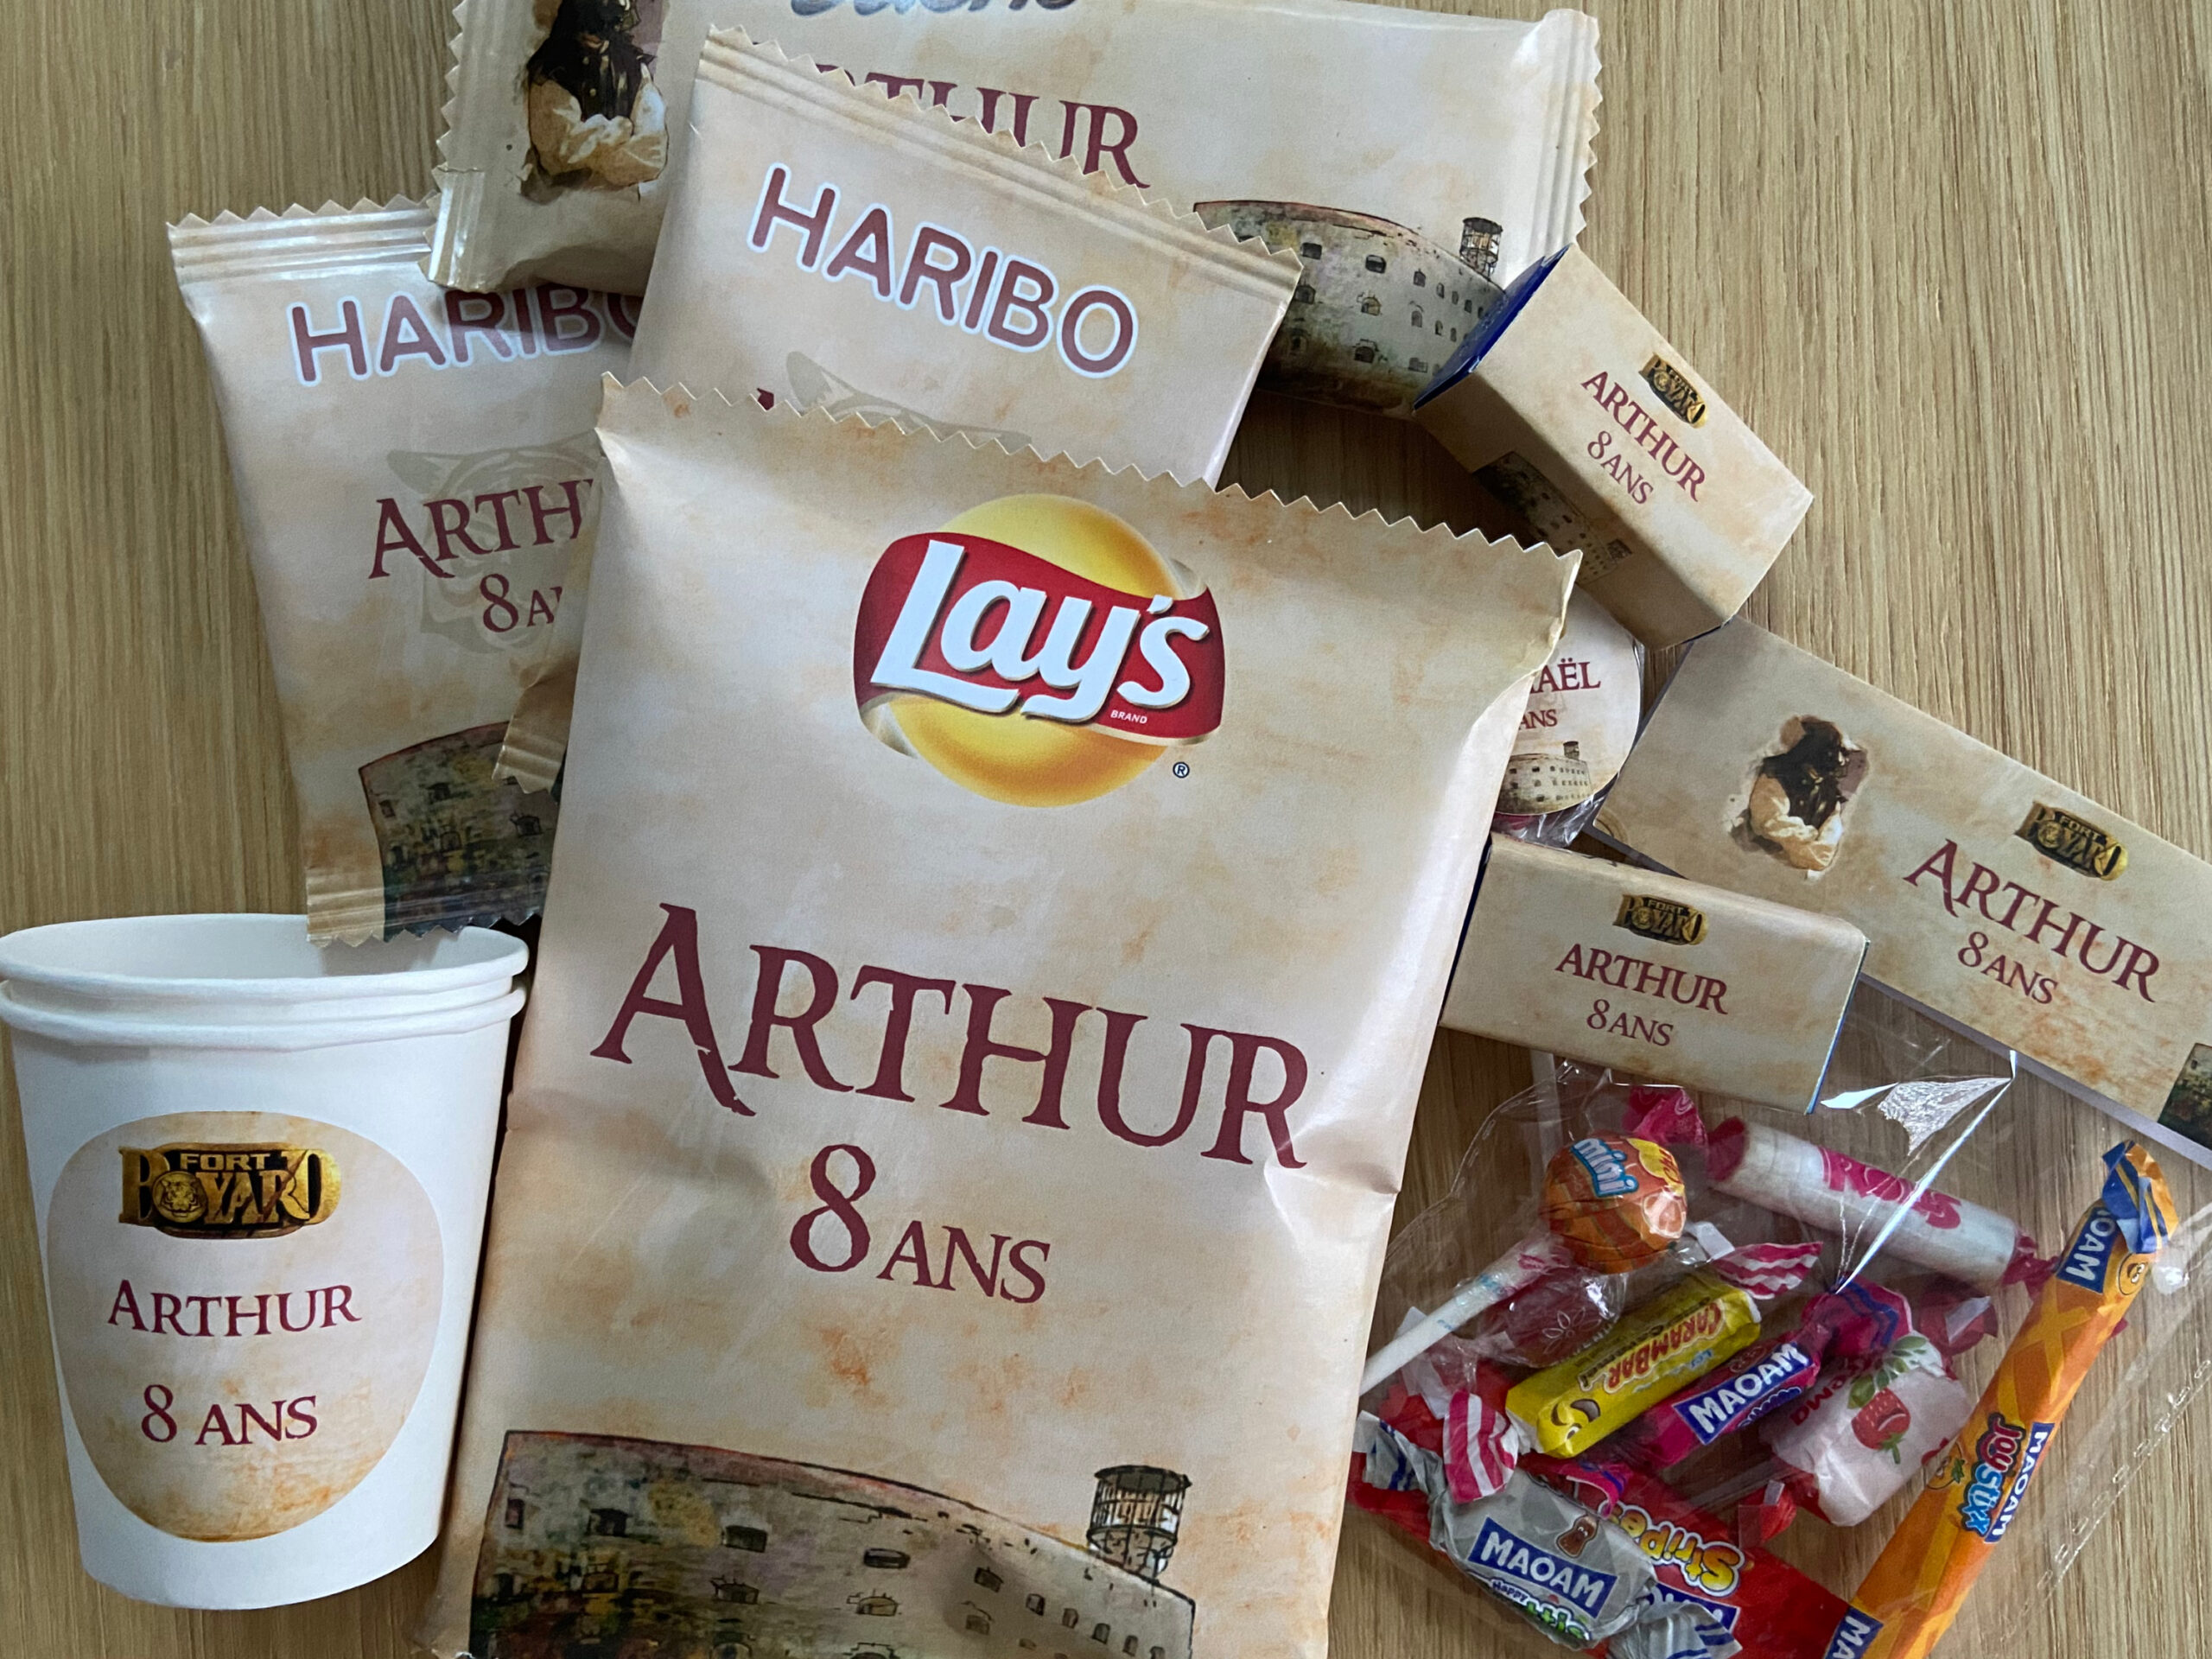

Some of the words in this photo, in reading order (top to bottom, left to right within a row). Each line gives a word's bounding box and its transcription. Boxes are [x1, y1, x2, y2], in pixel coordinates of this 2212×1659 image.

[748, 163, 1138, 378] HARIBO
[1581, 371, 1706, 502] ARTHUR
[1586, 430, 1607, 461] 8
[1600, 456, 1654, 505] ANS
[368, 478, 594, 580] ARTH
[479, 573, 520, 633] 8
[869, 538, 1210, 724] Lay's
[1529, 657, 1602, 695] AËL
[1109, 709, 1148, 725] BRAND
[1903, 837, 2160, 1004] ARTHUR
[1554, 943, 1728, 1015] ARTHUR
[1957, 931, 1990, 968] 8
[1980, 954, 2059, 1005] ANS
[590, 902, 1309, 1170] ARTHUR
[1586, 998, 1611, 1030] 8
[1607, 1012, 1675, 1047] ANS
[179, 1153, 270, 1172] FORT
[789, 1143, 876, 1273] 8
[876, 1219, 1052, 1304] ANS
[2065, 1210, 2116, 1281] OAM
[107, 1279, 362, 1338] ARTHUR
[140, 1383, 178, 1444] 8
[194, 1395, 319, 1446] ANS
[1688, 1342, 1809, 1434] MAOAM
[1992, 1431, 2049, 1535] MAOAM
[1480, 1531, 1605, 1609] MAOAM
